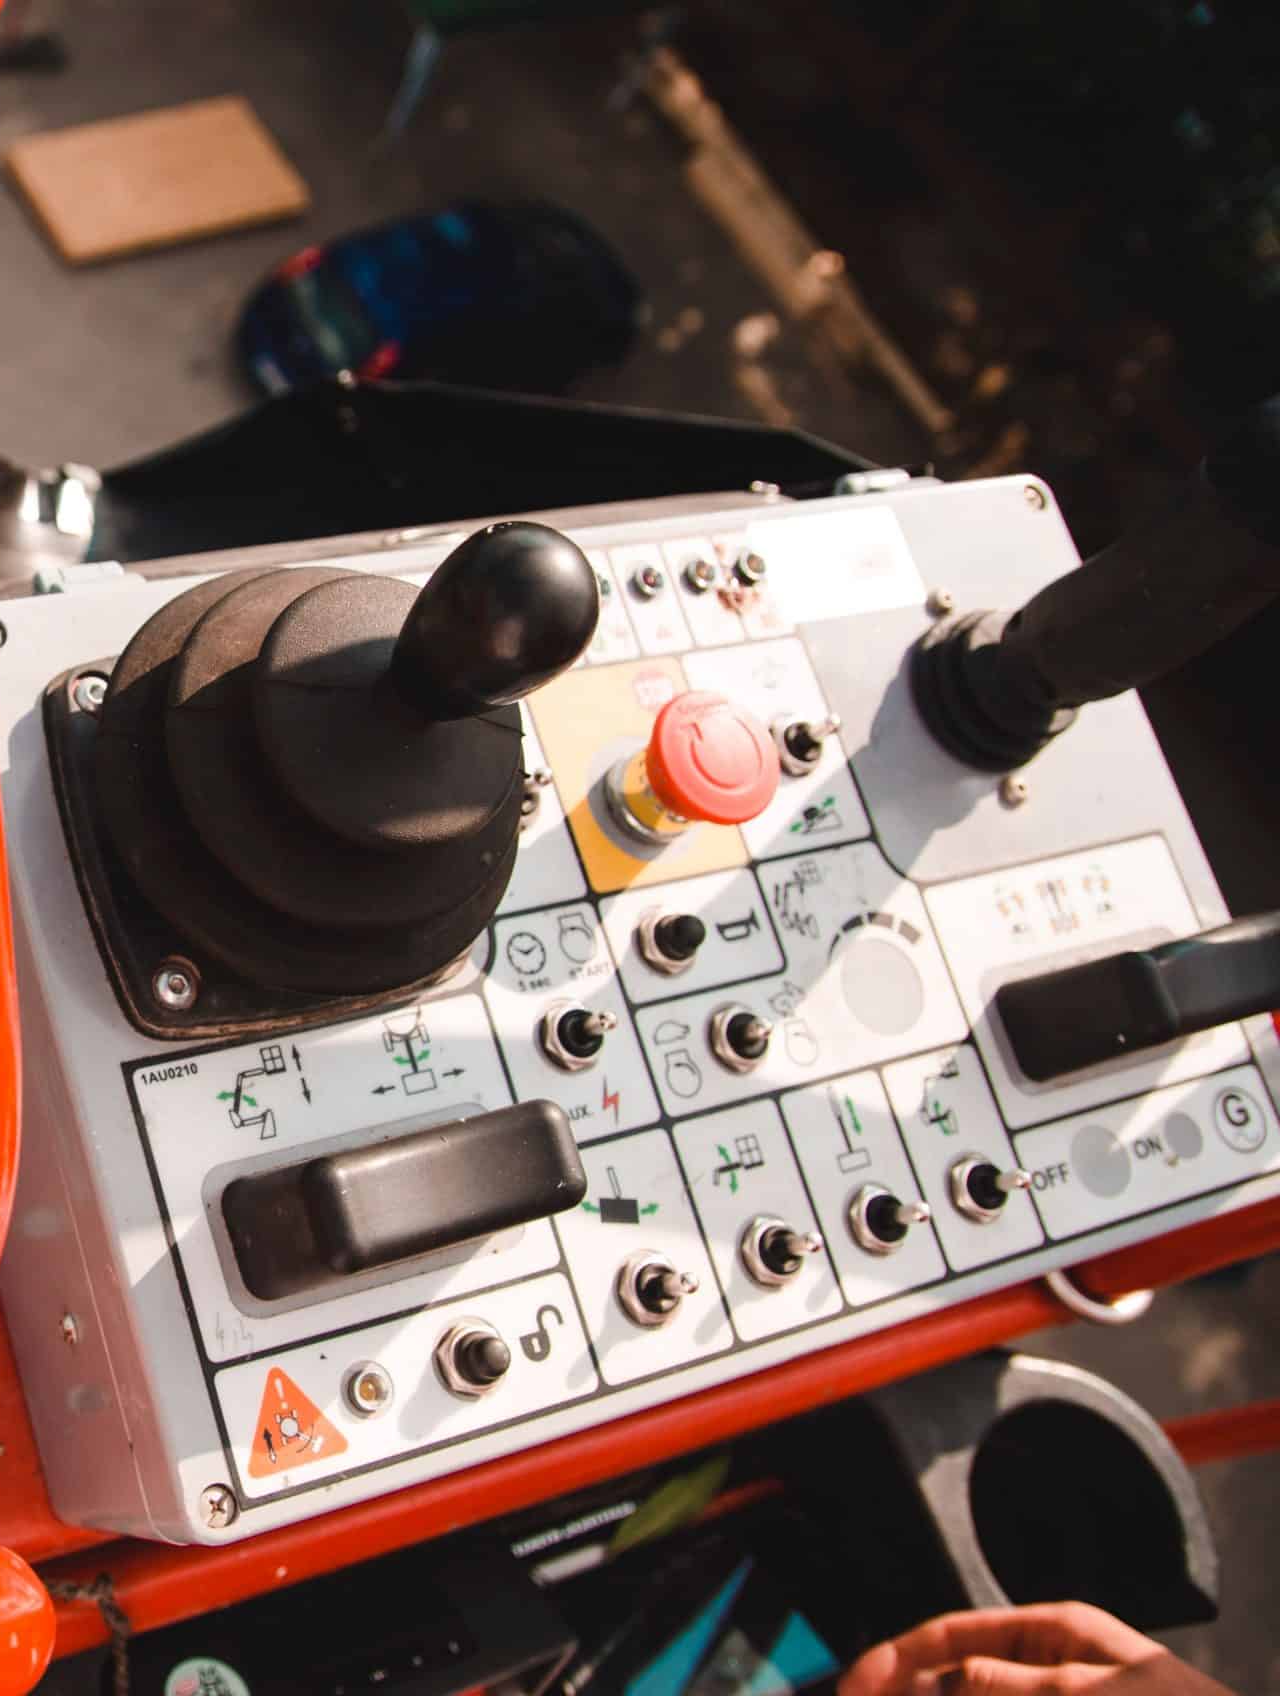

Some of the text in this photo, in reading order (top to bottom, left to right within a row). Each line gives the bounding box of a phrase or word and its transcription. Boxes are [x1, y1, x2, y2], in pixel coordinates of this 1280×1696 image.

[141, 1062, 198, 1085] 1AU0210
[1221, 1093, 1250, 1127] G
[1132, 1135, 1163, 1160] ON
[1031, 1163, 1068, 1191] OFF
